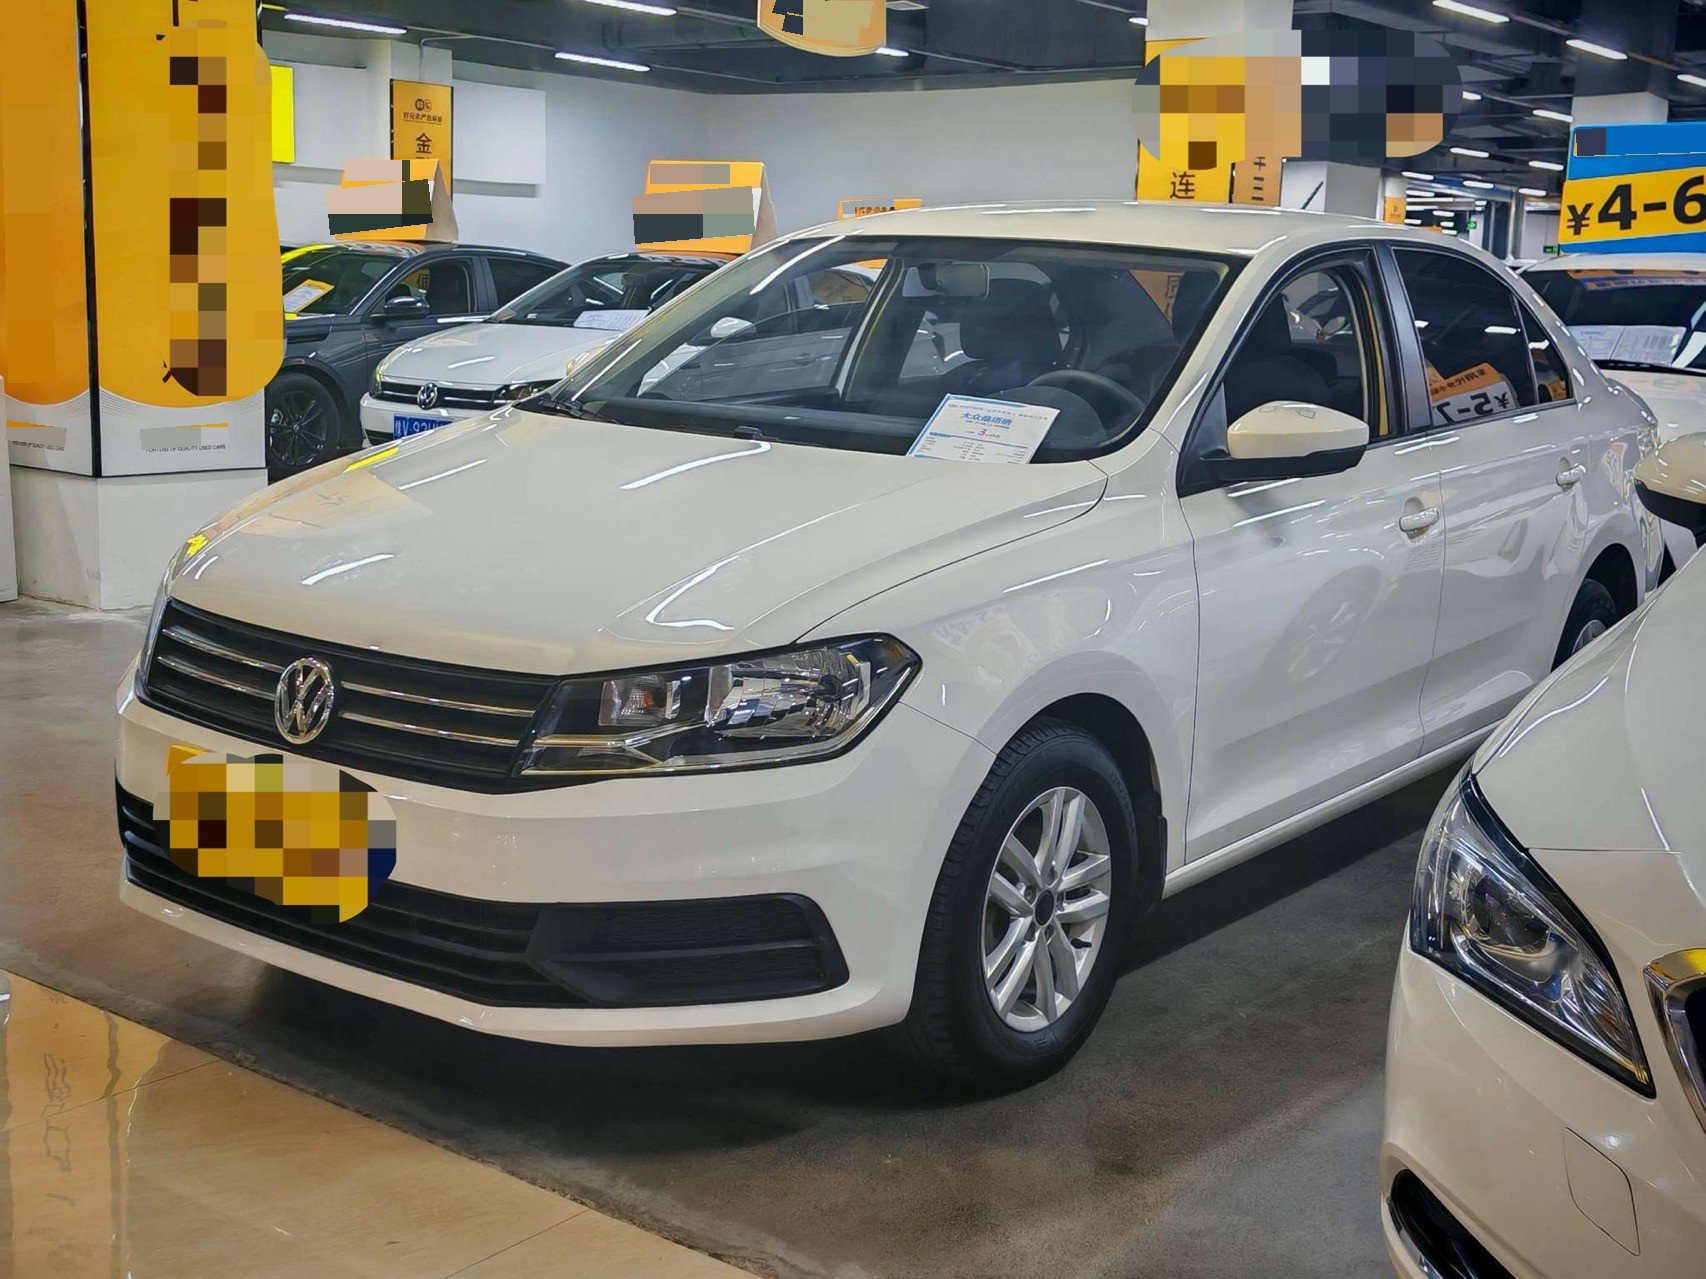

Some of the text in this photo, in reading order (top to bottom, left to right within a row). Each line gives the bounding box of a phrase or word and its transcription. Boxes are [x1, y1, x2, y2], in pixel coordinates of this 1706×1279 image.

[415, 132, 432, 159] 金
[1169, 171, 1196, 200] 连
[1566, 174, 1706, 237] ¥4-6
